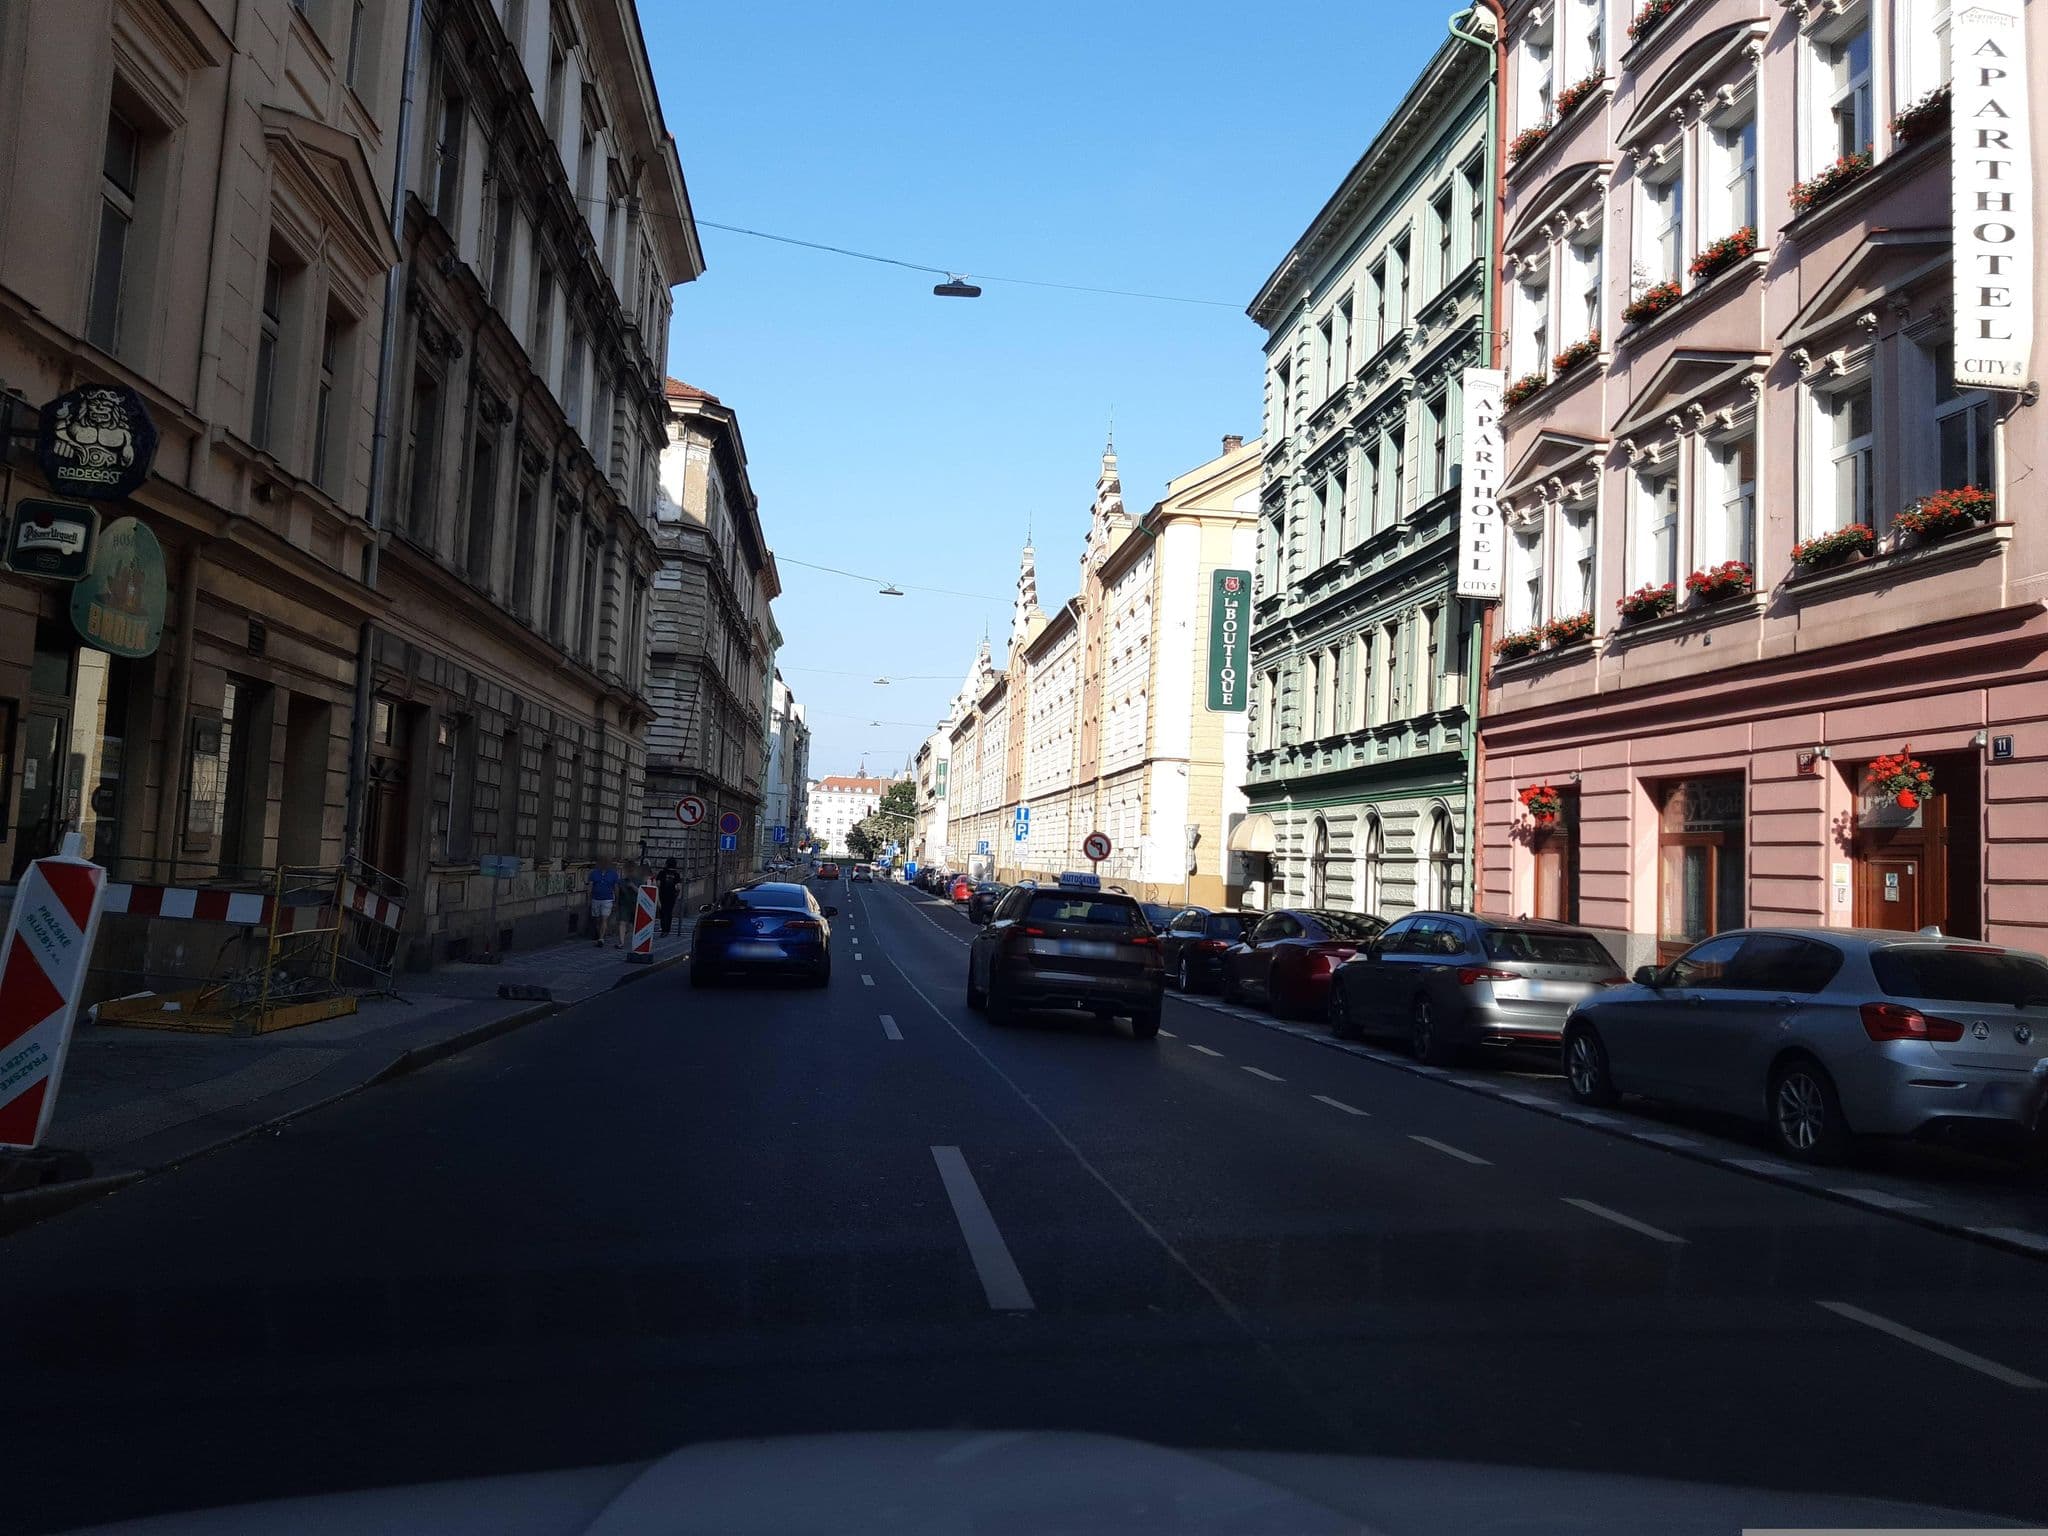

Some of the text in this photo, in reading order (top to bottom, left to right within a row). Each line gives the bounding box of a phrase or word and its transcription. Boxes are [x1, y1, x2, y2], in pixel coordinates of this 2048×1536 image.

[1972, 37, 2016, 341] APARTHOTEL
[1964, 358, 2007, 375] CITY
[57, 465, 121, 485] RADEGAST
[1471, 398, 1495, 571] APARTHOTEL
[51, 527, 78, 544] Urquell
[1463, 580, 1489, 591] CITY
[1220, 597, 1239, 705] La BOUTIQUE
[1997, 738, 2007, 752] 11
